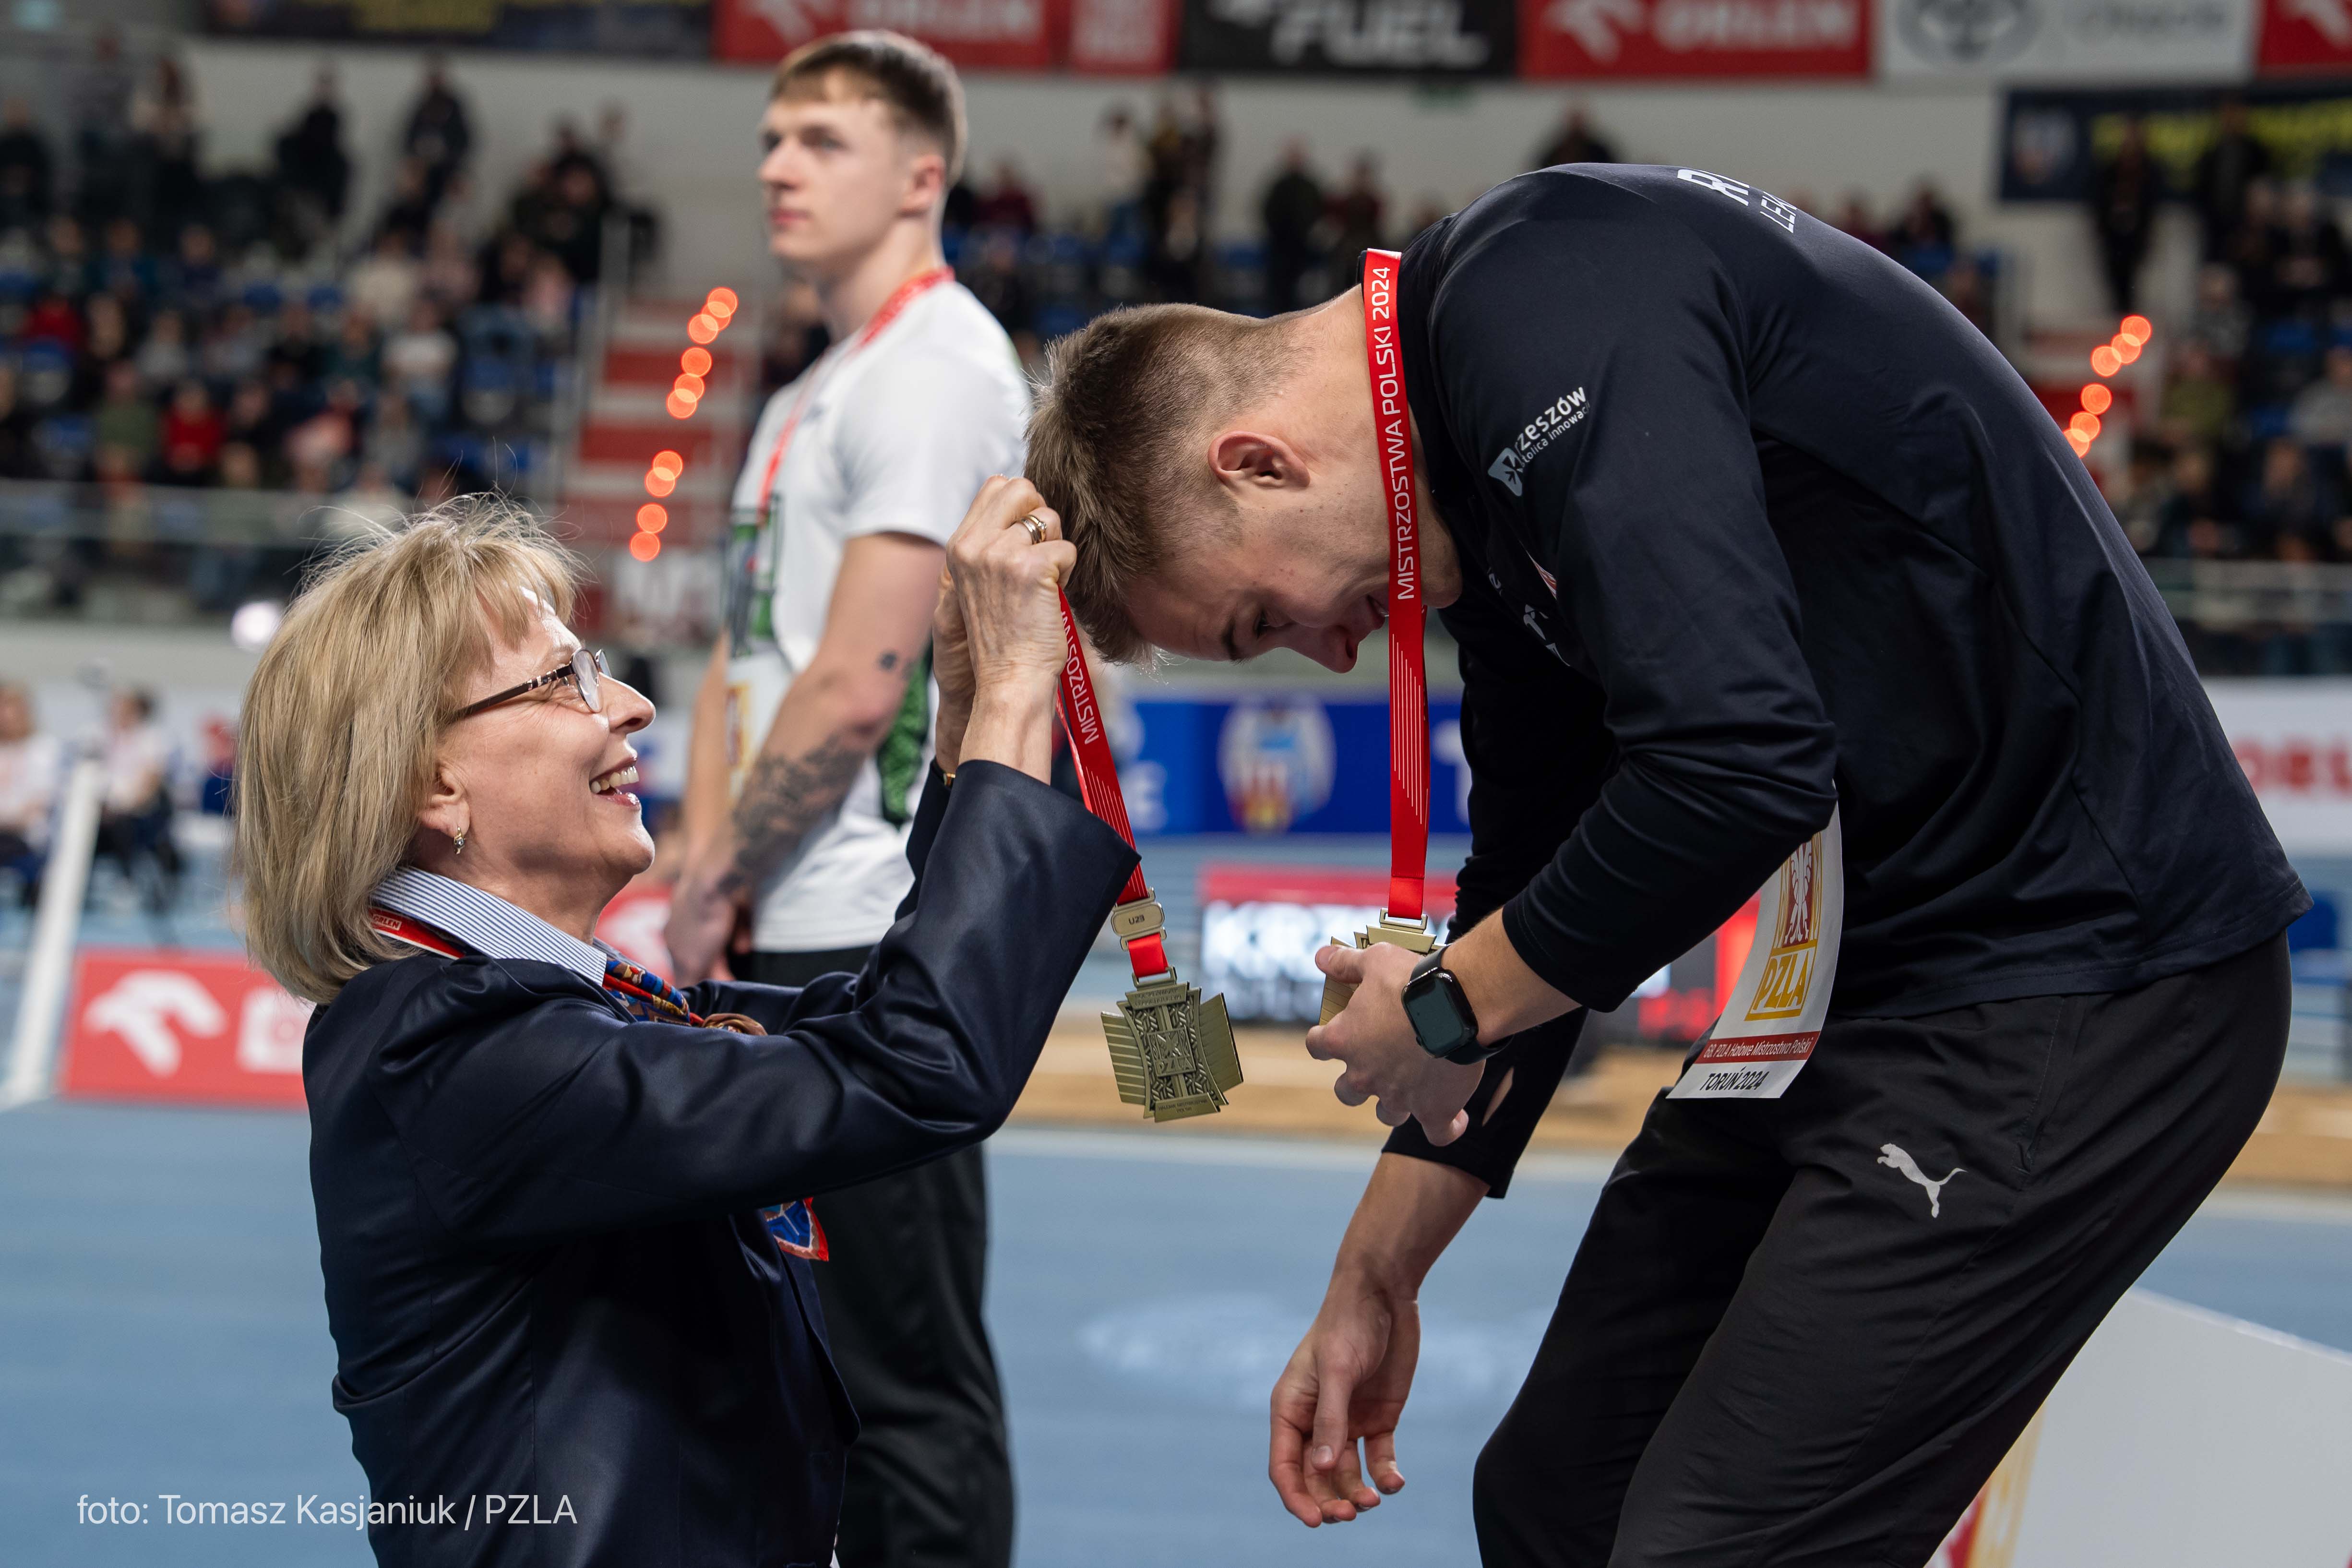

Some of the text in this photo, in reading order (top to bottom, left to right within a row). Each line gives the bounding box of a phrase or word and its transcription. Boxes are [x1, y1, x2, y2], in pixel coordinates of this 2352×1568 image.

[1372, 267, 1414, 600] MISTRZOSTWA POLSKI 2024
[1753, 950, 1808, 1010] PZLA
[1728, 1041, 1754, 1057] Halowe
[1751, 1040, 1792, 1056] Mistrzostwa
[1789, 1037, 1814, 1054] Polski
[1699, 1065, 1770, 1091] TORUŃ 2024
